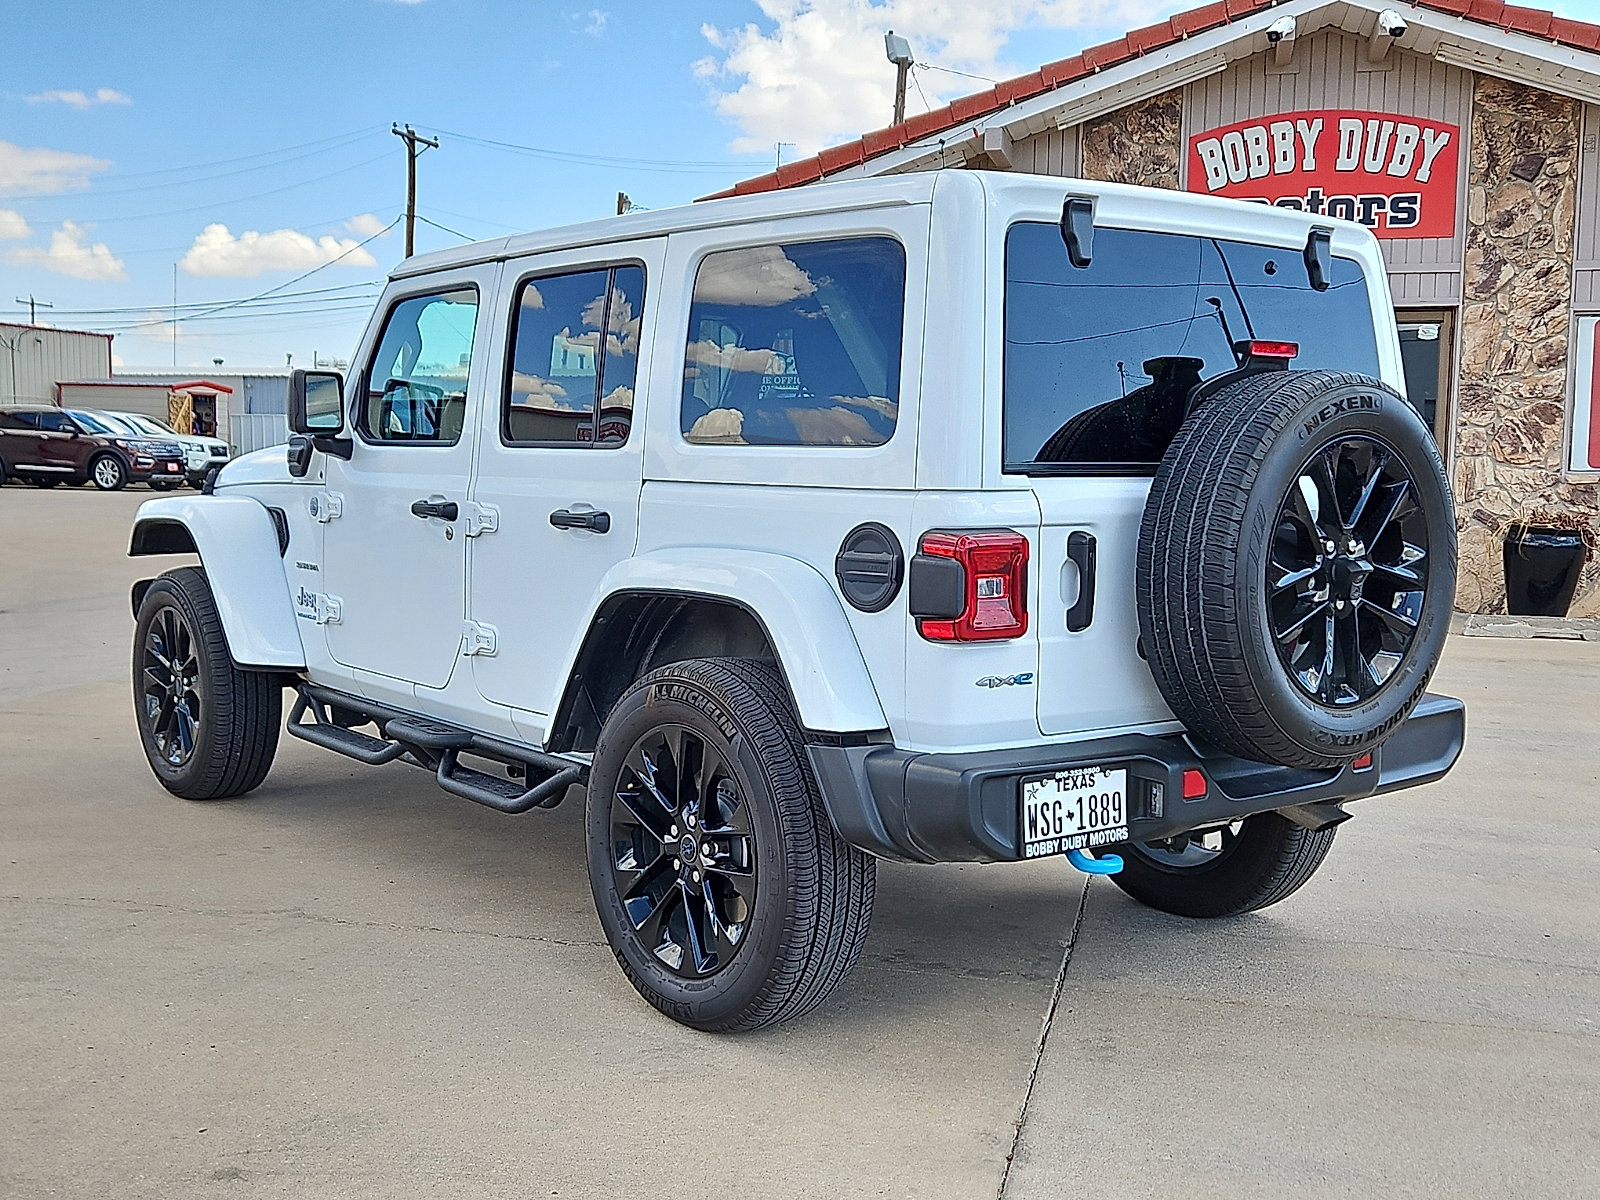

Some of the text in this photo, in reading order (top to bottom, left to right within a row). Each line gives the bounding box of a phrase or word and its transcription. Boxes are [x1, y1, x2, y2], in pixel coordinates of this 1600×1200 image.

[1196, 117, 1451, 192] BOBBY DUBY
[1232, 188, 1421, 228] tors
[1304, 395, 1373, 435] NEXEN
[669, 684, 739, 738] MICHELIN
[1055, 773, 1096, 792] TEXAS
[1027, 791, 1122, 840] WSG 1889
[1026, 827, 1129, 857] BOBBY DUBY MOTORS
